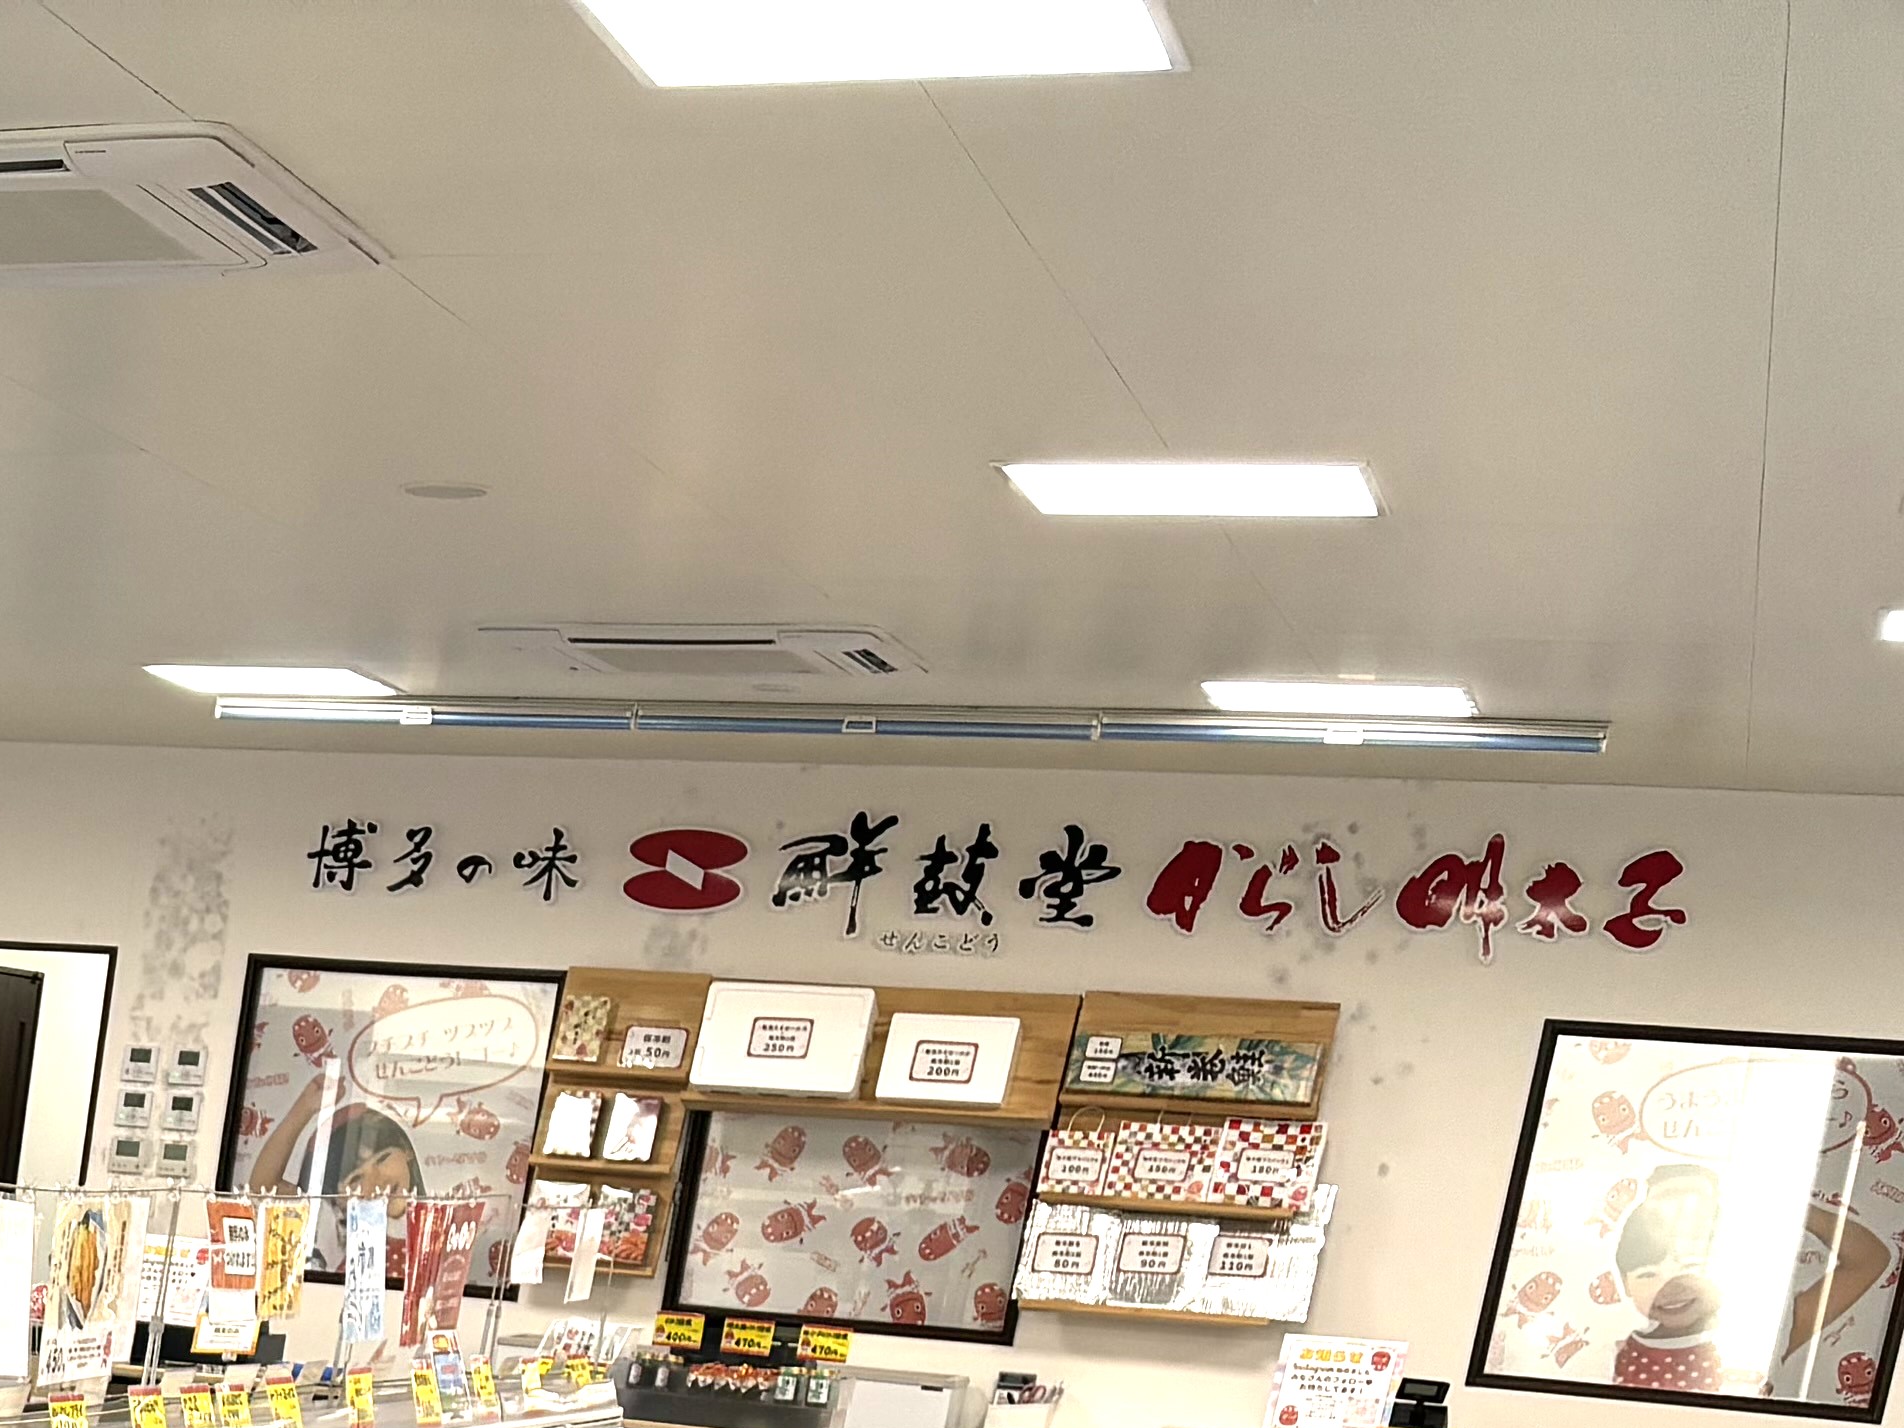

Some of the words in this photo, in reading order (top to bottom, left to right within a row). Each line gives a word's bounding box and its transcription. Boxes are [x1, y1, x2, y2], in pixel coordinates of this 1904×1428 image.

[307, 818, 582, 902] 博多の味
[878, 929, 1000, 954] せんこどう
